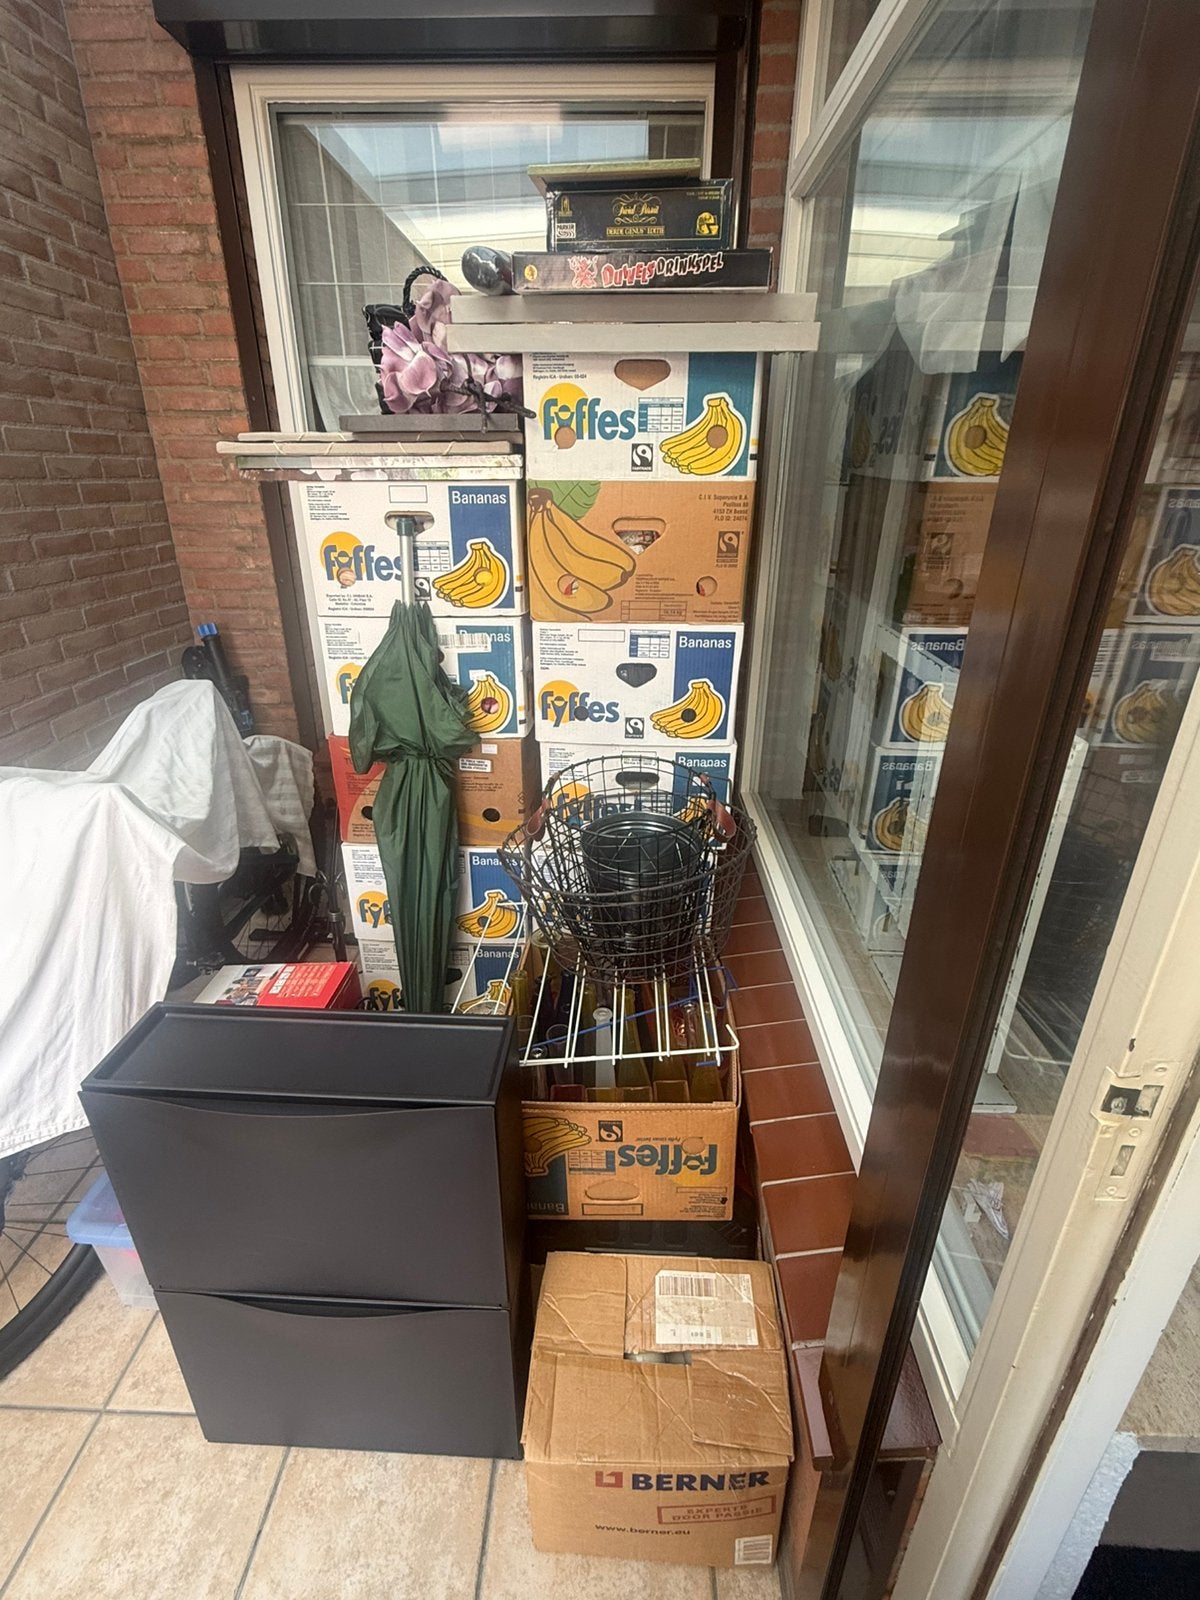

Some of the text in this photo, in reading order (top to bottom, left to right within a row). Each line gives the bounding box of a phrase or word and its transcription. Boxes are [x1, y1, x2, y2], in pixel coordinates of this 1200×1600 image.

[452, 490, 507, 505] Bananas
[679, 636, 732, 649] Bananas
[678, 756, 727, 768] Bananas
[472, 855, 518, 867] Banas
[476, 948, 520, 959] Bananas
[632, 1470, 770, 1491] BERNER
[672, 1513, 710, 1521] DOOR
[595, 1524, 691, 1535] www.berner.eu
